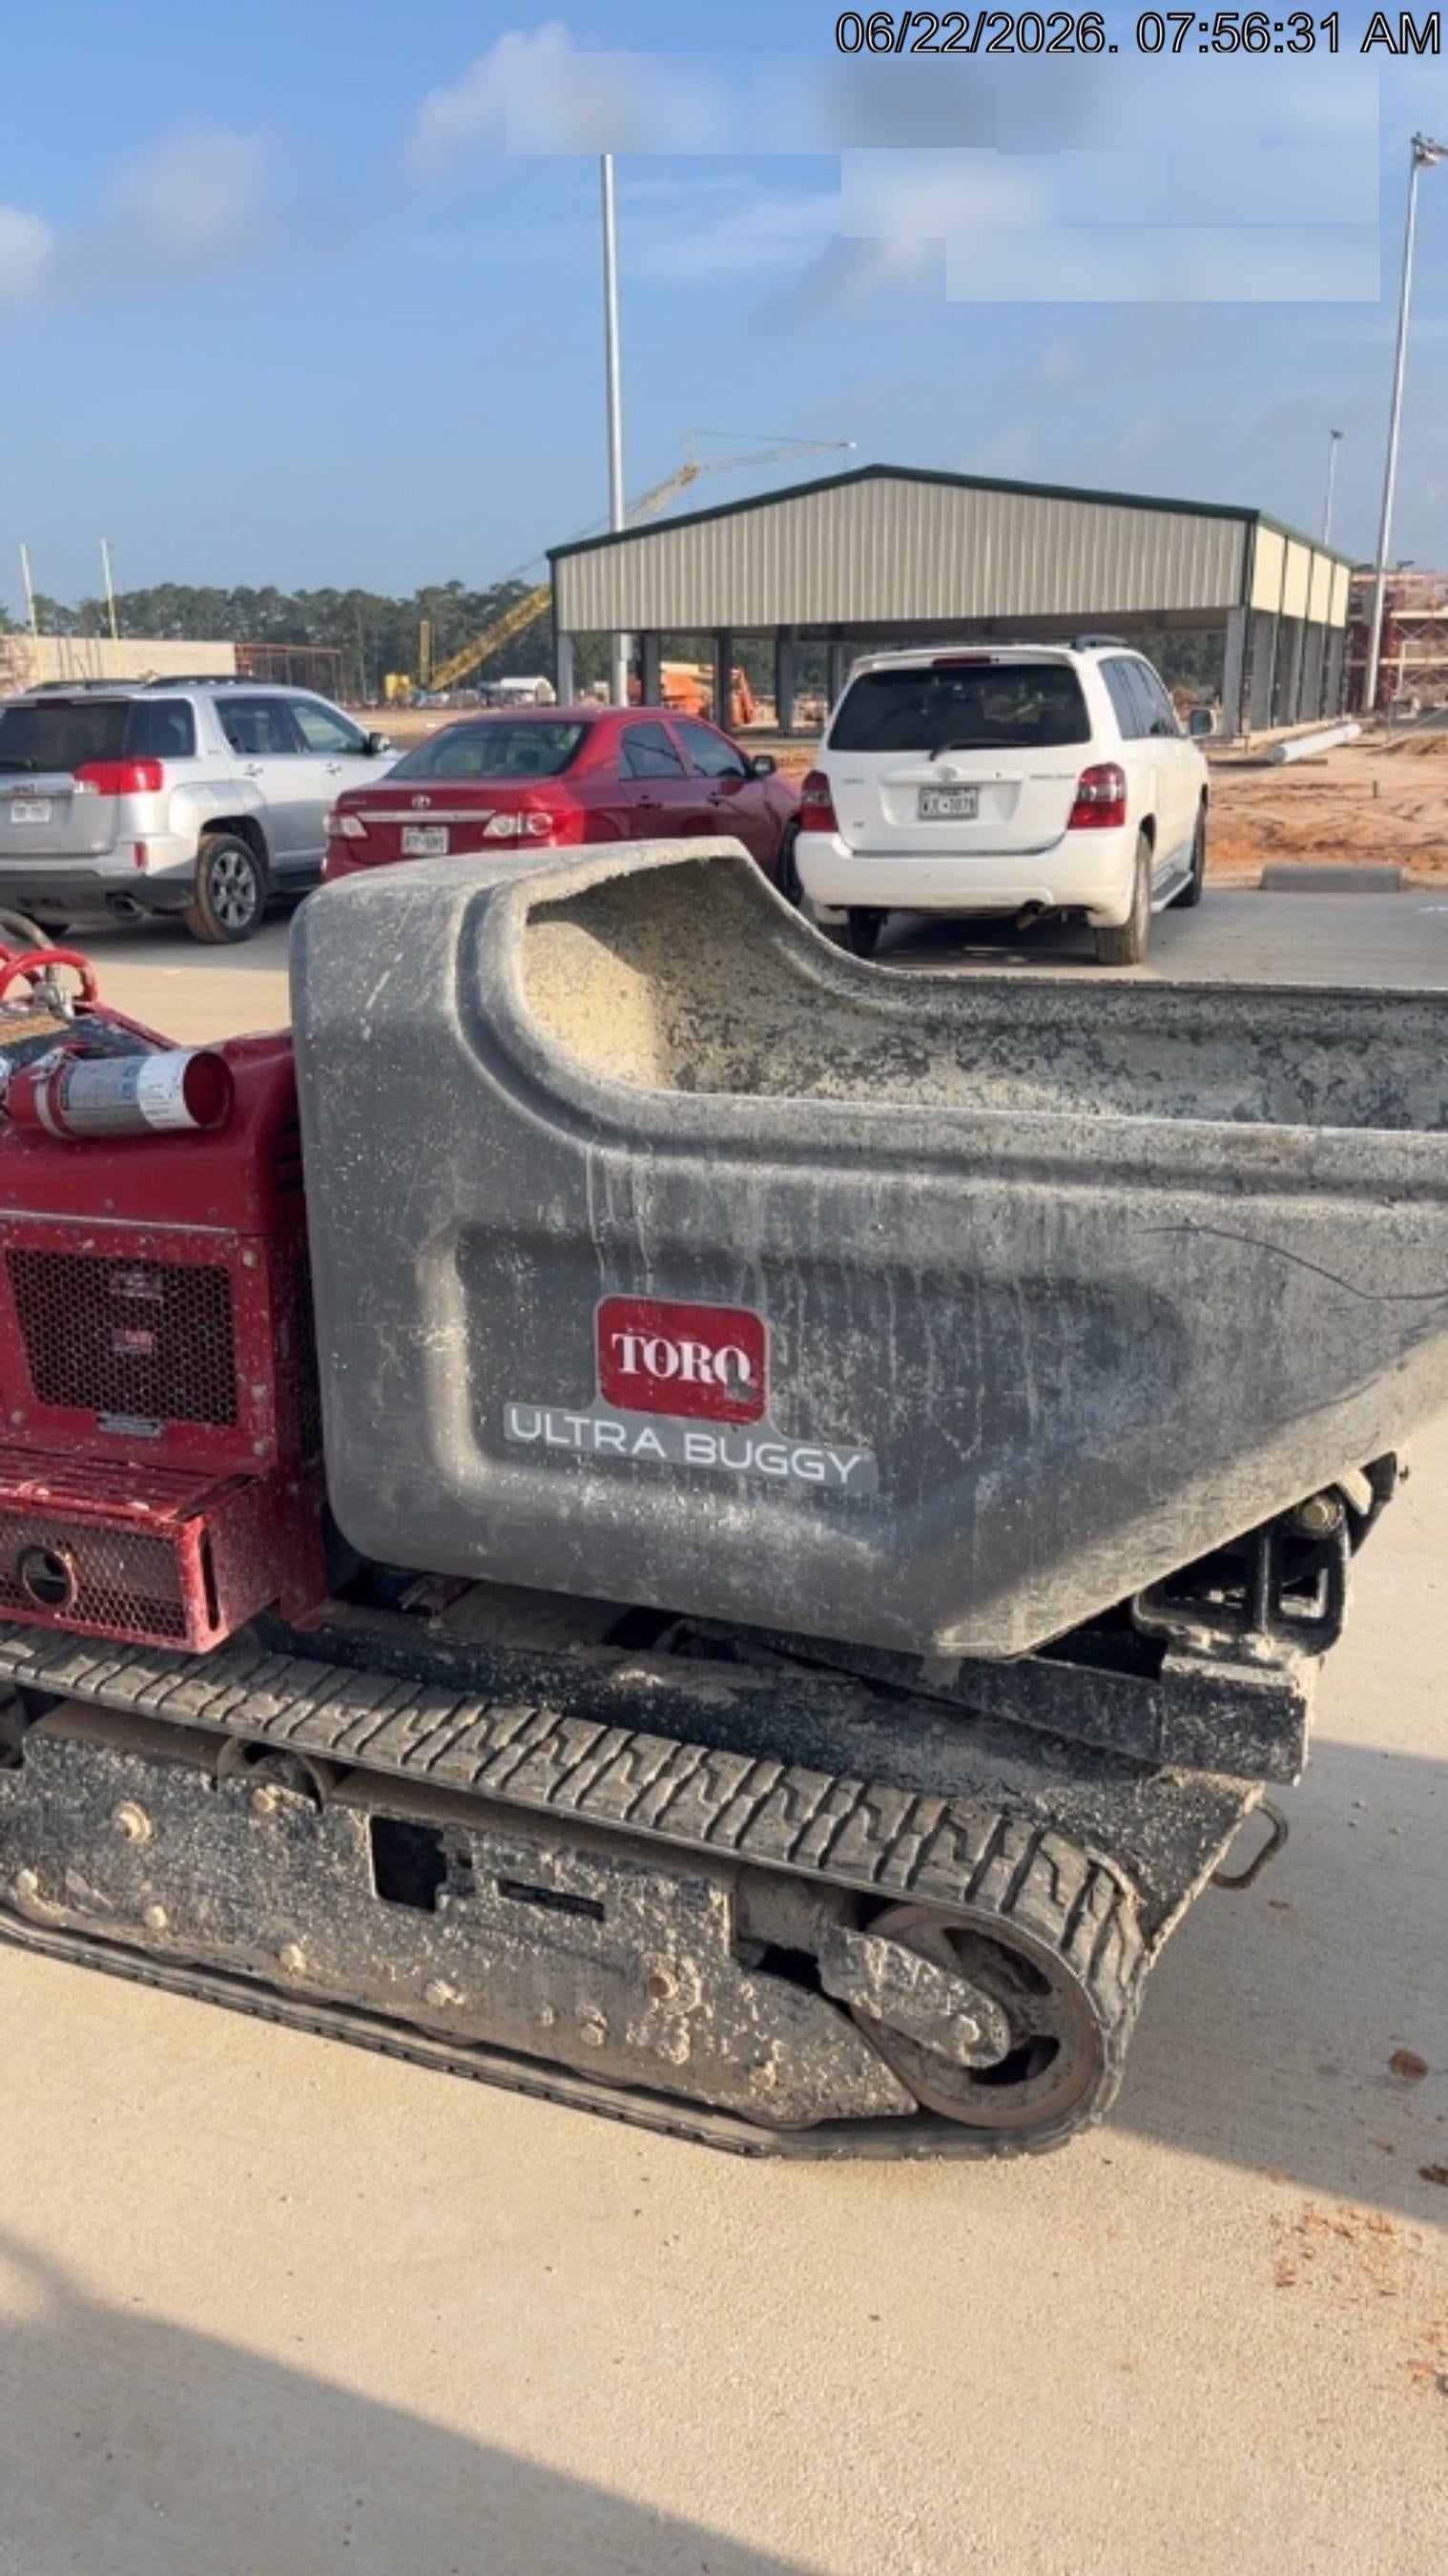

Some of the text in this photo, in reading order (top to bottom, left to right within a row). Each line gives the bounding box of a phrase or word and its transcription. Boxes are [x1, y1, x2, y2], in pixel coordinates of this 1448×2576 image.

[610, 1332, 752, 1388] TORO
[509, 1406, 860, 1485] ULTRA BUGGY
